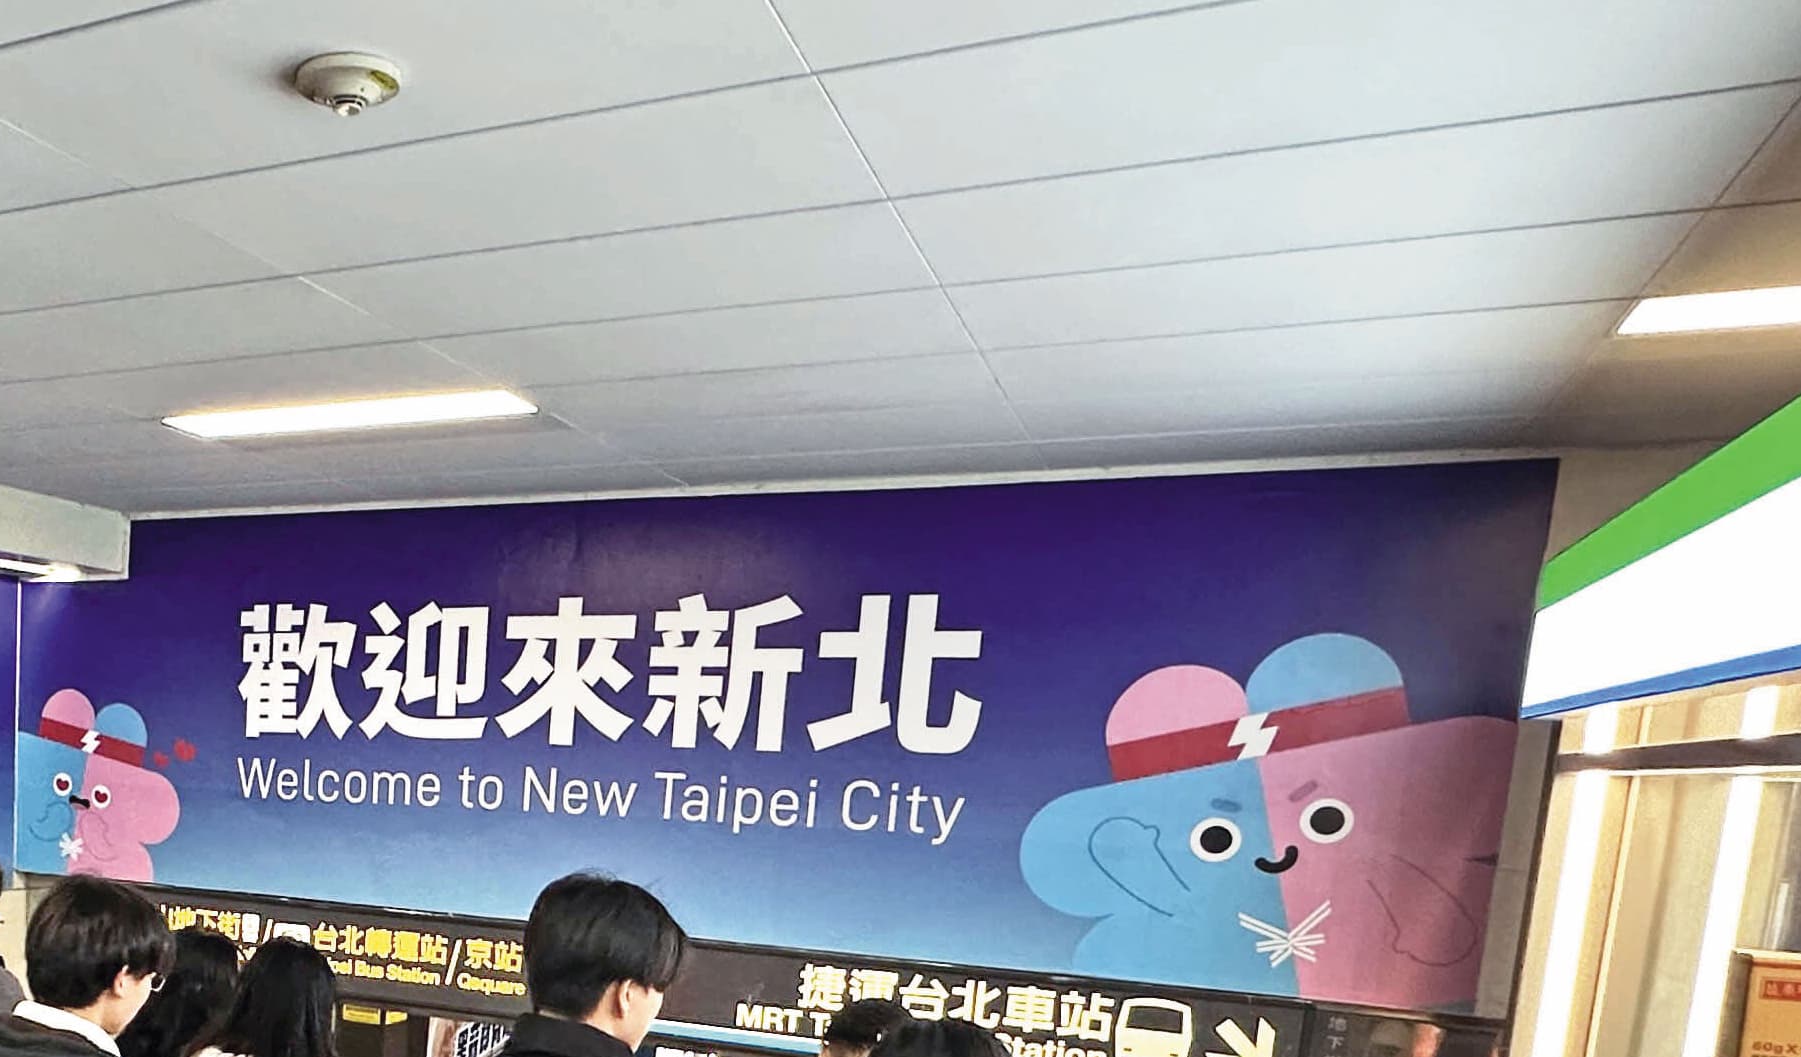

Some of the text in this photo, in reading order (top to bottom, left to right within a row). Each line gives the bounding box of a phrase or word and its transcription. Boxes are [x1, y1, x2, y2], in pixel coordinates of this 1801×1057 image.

[238, 593, 982, 755] 歡迎來新北
[236, 757, 967, 845] Welcome to New Taipei City
[354, 960, 384, 979] Bus
[386, 964, 440, 986] Station
[797, 962, 1115, 1043] 捷運台北車站
[736, 1003, 803, 1033] MRT
